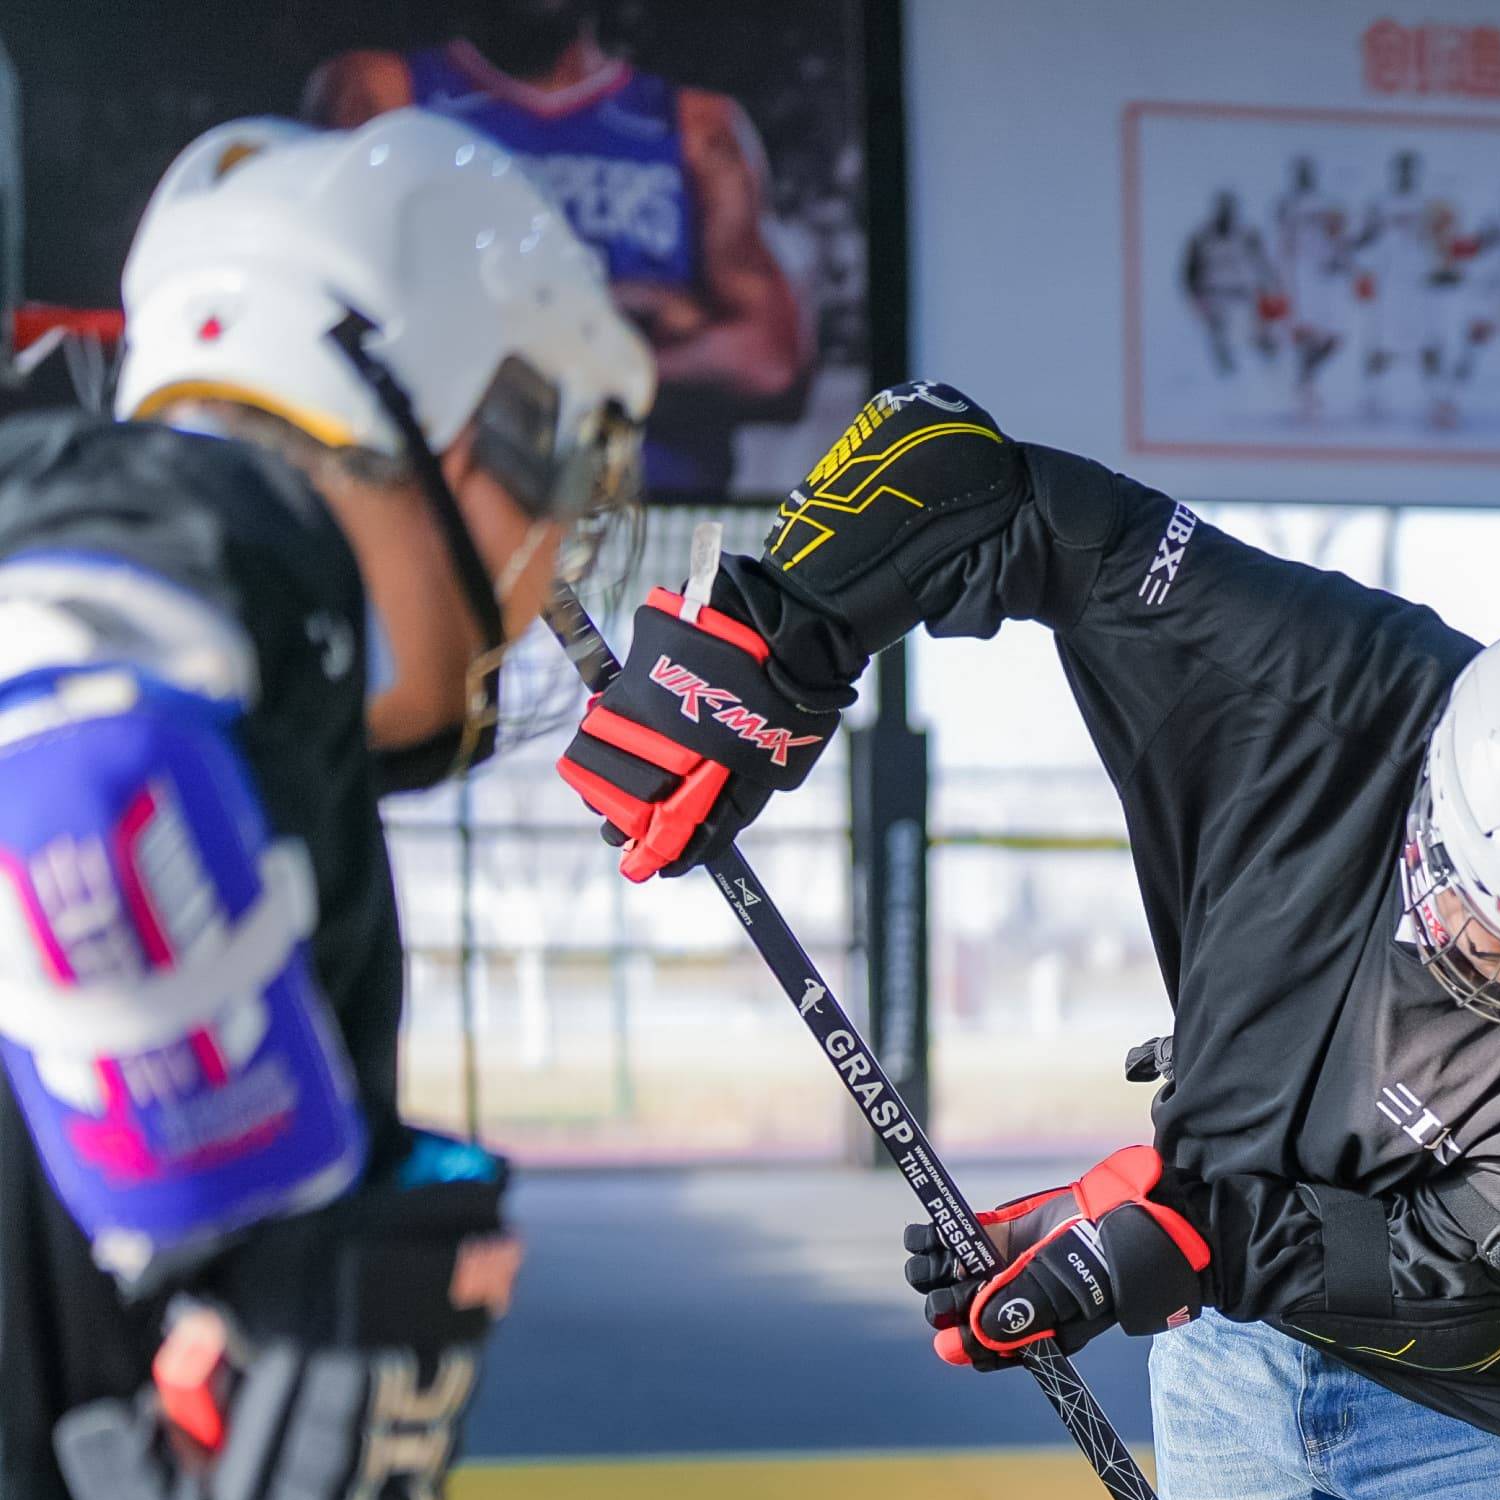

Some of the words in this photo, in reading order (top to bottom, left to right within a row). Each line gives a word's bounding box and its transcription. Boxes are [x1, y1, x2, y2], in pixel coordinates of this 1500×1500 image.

[649, 654, 823, 766] VIK-MAX
[825, 1029, 914, 1146] GRASP
[900, 1152, 929, 1189] THE
[927, 1197, 986, 1275] PRESENT
[974, 1240, 995, 1268] JUNIOR
[1067, 1252, 1105, 1306] CRAFTED
